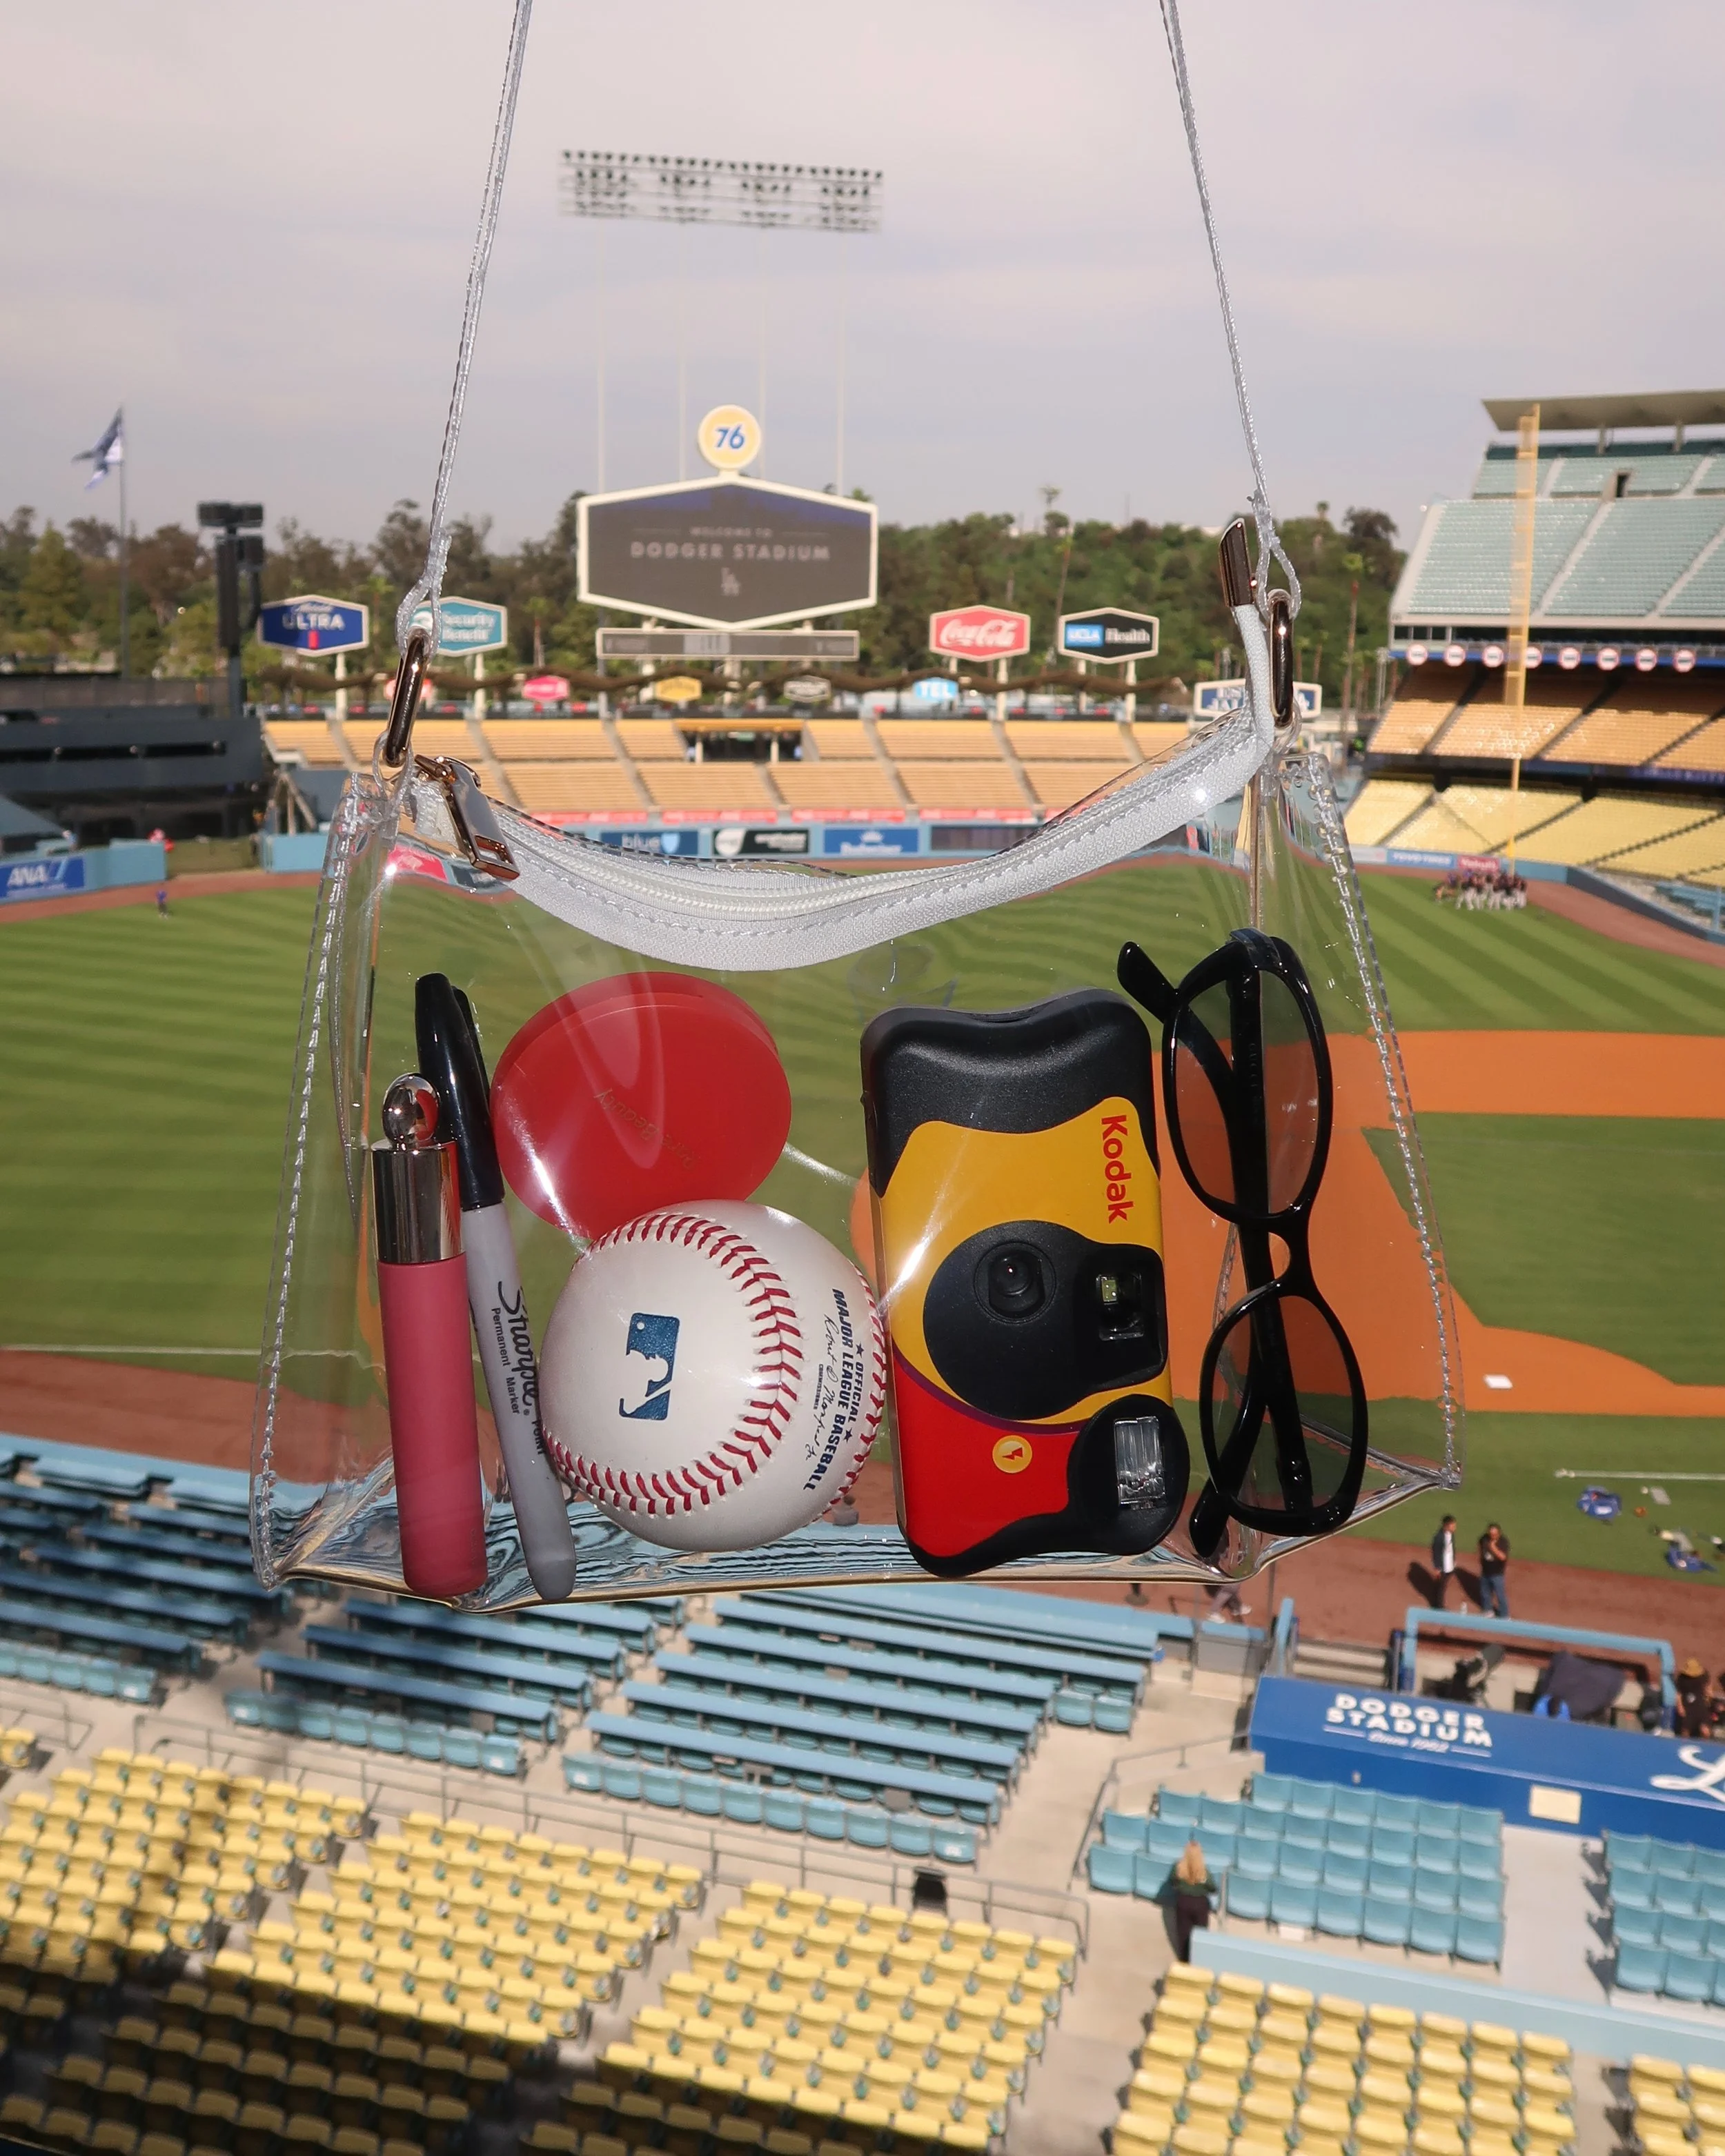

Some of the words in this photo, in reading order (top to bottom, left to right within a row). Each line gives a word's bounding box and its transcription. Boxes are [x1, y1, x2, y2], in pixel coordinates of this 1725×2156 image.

[716, 424, 745, 449] 76
[630, 541, 723, 560] DODGER
[732, 543, 830, 562] STADIUM
[282, 613, 344, 631] ULTRA
[442, 611, 495, 628] Security
[1068, 627, 1101, 642] UCLA
[1105, 627, 1150, 644] Health
[8, 864, 48, 887] ANA
[1101, 1114, 1134, 1225] Kodak
[832, 1288, 854, 1347] MAJOR
[491, 1307, 511, 1367] Permanent
[505, 1376, 520, 1415] Marker
[497, 1280, 539, 1407] Sharpie
[838, 1352, 854, 1410] LEAGUE
[847, 1361, 864, 1423] OFFICIAL
[803, 1413, 847, 1491] BASEBALL
[1325, 1707, 1494, 1748] STADIUM
[1335, 1692, 1486, 1731] DODGER
